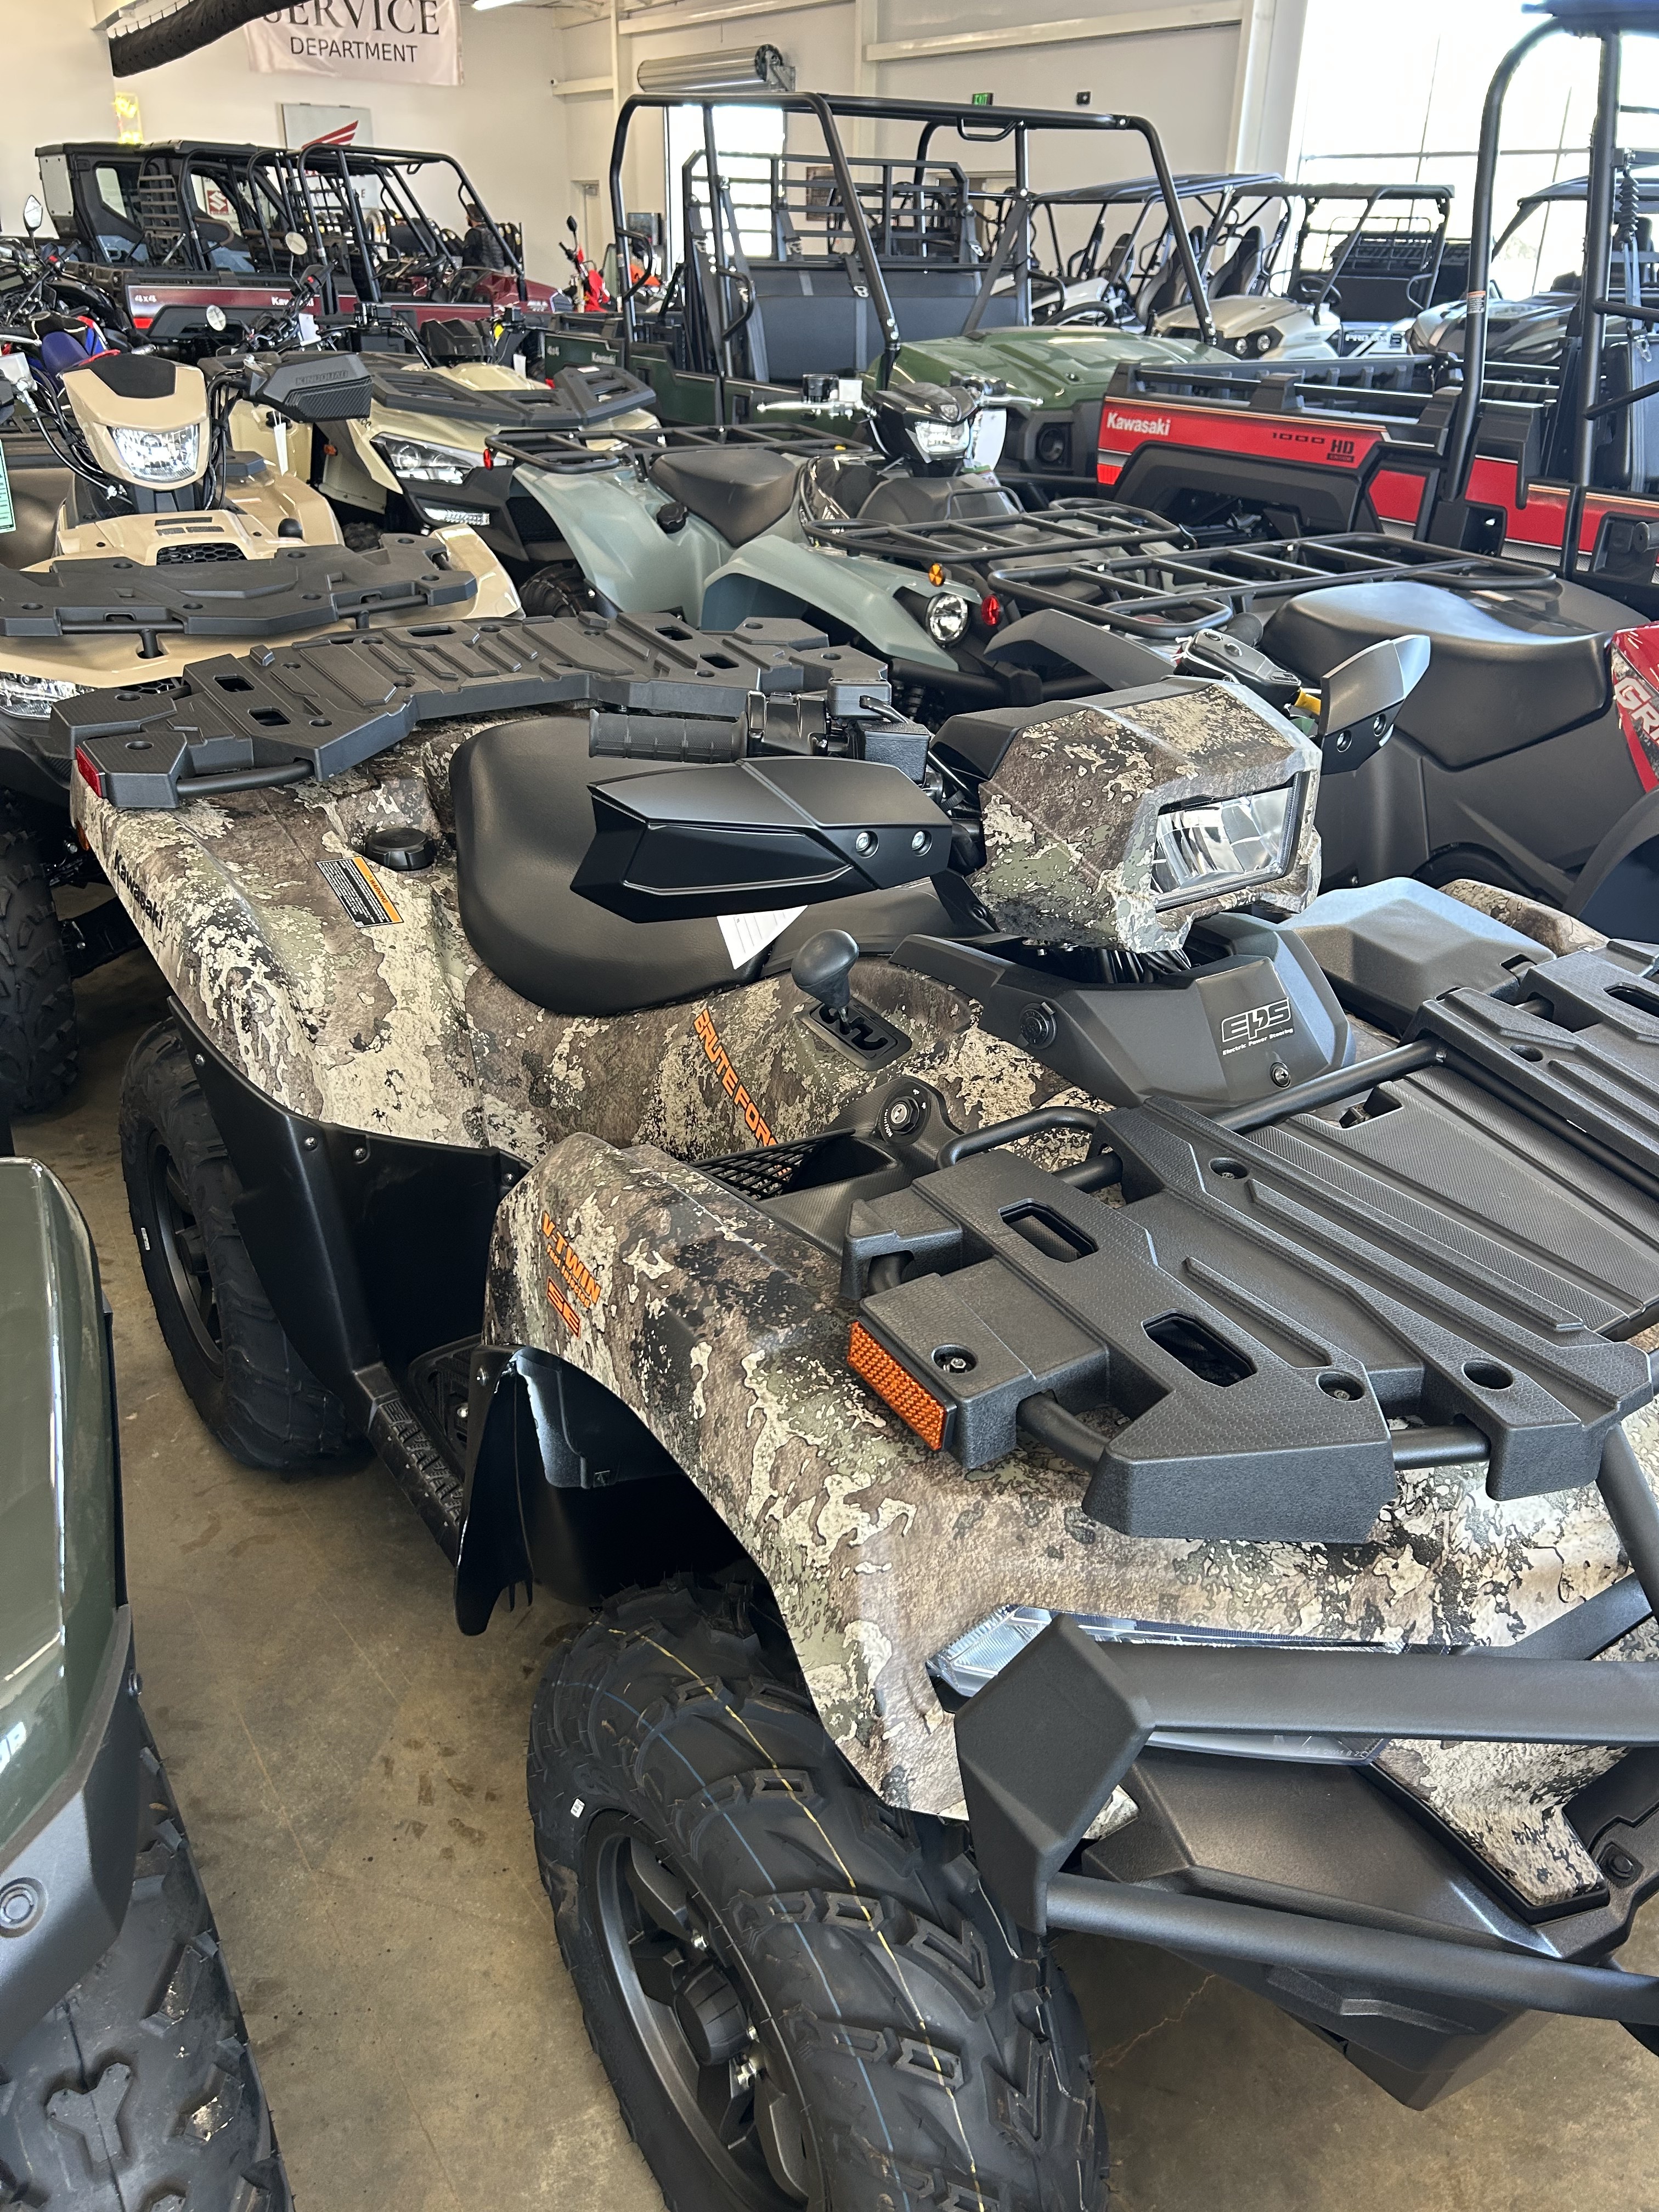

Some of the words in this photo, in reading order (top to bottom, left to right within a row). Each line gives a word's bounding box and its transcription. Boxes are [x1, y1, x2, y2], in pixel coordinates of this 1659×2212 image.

[290, 36, 418, 63] DEPARTMENT
[134, 295, 157, 303] 4x4
[1107, 412, 1171, 436] Kawasaki
[1273, 432, 1325, 444] 1000
[1330, 439, 1355, 454] HD
[1615, 676, 1659, 744] GR
[114, 849, 164, 932] Kawasaki
[369, 879, 388, 904] WARNING
[1221, 997, 1291, 1042] EPS
[1222, 1043, 1246, 1055] Electric
[1248, 1036, 1268, 1046] Power
[1269, 1028, 1294, 1039] Steering
[694, 1008, 740, 1097] BRUTE
[734, 1084, 782, 1151] FOR
[542, 1211, 601, 1305] V-TWIN
[546, 1243, 561, 1268] Fuel
[561, 1265, 591, 1308] Injected
[548, 1277, 580, 1339] SE
